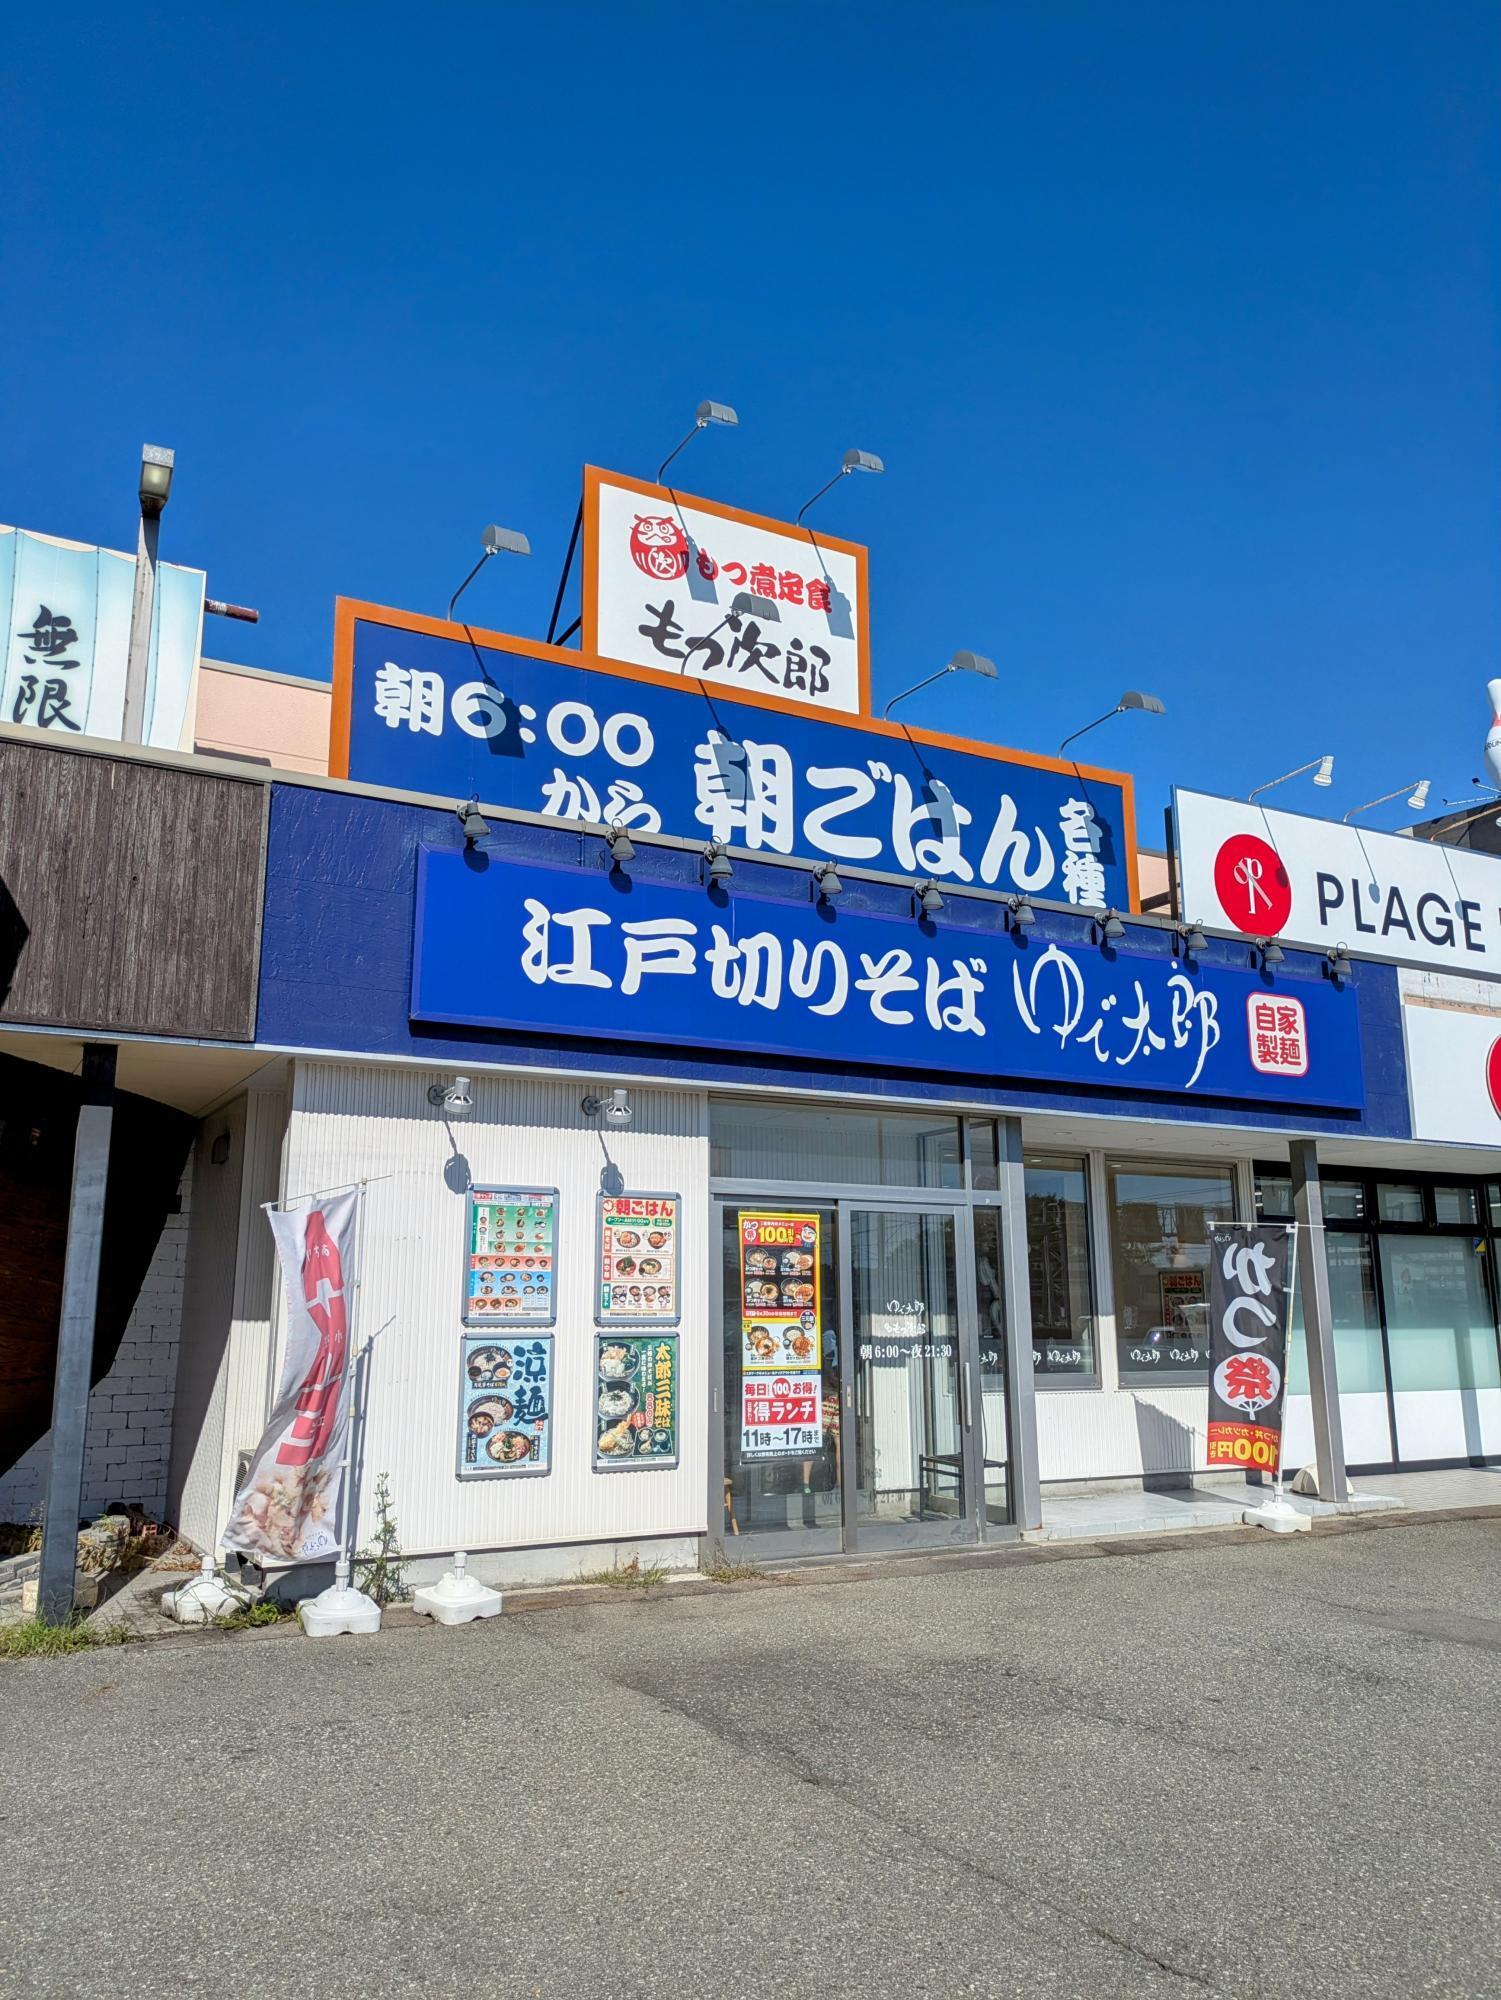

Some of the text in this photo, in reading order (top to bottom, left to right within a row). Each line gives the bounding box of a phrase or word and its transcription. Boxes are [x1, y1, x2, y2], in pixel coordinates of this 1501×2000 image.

[697, 548, 832, 613] もつ煮定食
[13, 604, 81, 731] 無限
[638, 599, 831, 696] もつ次郎
[374, 662, 654, 766] 朝6:00
[541, 768, 661, 833] から
[694, 729, 1055, 891] 朝ごはん
[1059, 797, 1107, 909] 各種
[1316, 872, 1486, 952] PLAGE
[521, 898, 1220, 1088] 江戸切りそば ゆで太郎
[1255, 1003, 1299, 1034] 自家
[1256, 1033, 1302, 1066] 製麺
[617, 1199, 673, 1217] 朝ごはん
[513, 1341, 548, 1426] 涼麺
[745, 1383, 766, 1396] 毎日
[753, 1401, 814, 1422] 得ランチ
